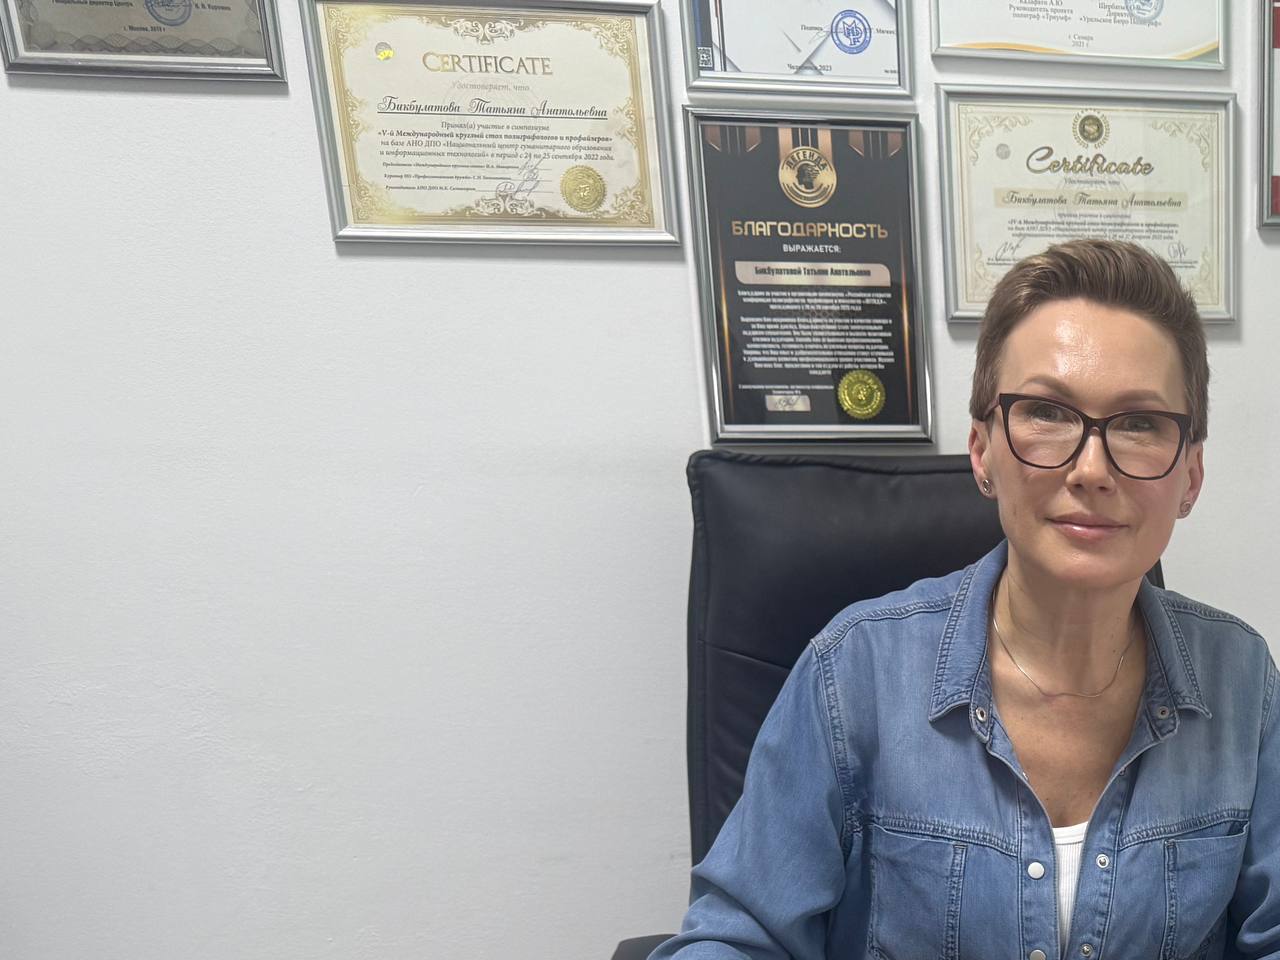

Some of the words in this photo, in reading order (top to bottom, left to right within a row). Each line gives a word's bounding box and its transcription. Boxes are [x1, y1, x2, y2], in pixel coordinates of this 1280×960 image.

[422, 51, 553, 75] CERTIFICATE
[377, 95, 460, 115] Бикбулатова
[469, 97, 525, 115] Татьяна
[530, 100, 608, 118] Анатольевна
[785, 149, 828, 172] ЛЕГЕНДА
[1026, 146, 1154, 177] Certificate
[731, 220, 889, 240] БЛАГОДАРНОСТЬ
[782, 243, 842, 254] ВЫРАЖАЕТСЯ:
